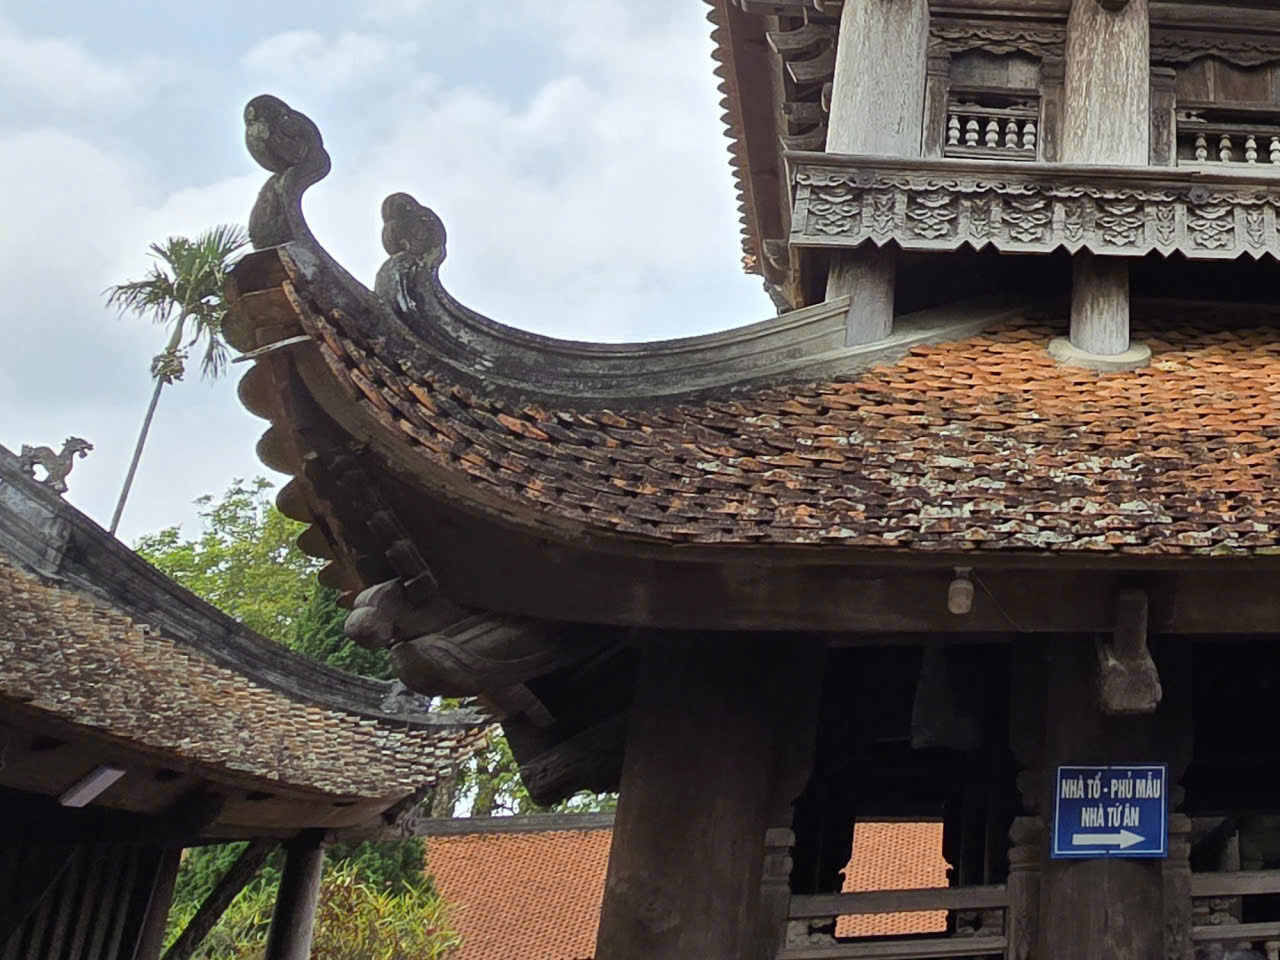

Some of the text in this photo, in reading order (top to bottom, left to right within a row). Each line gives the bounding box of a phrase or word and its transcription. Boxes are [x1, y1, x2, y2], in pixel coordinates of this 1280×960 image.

[1062, 775, 1085, 799] NHÀ
[1111, 771, 1133, 799] PHỦ
[1081, 803, 1104, 827] NHÀ
